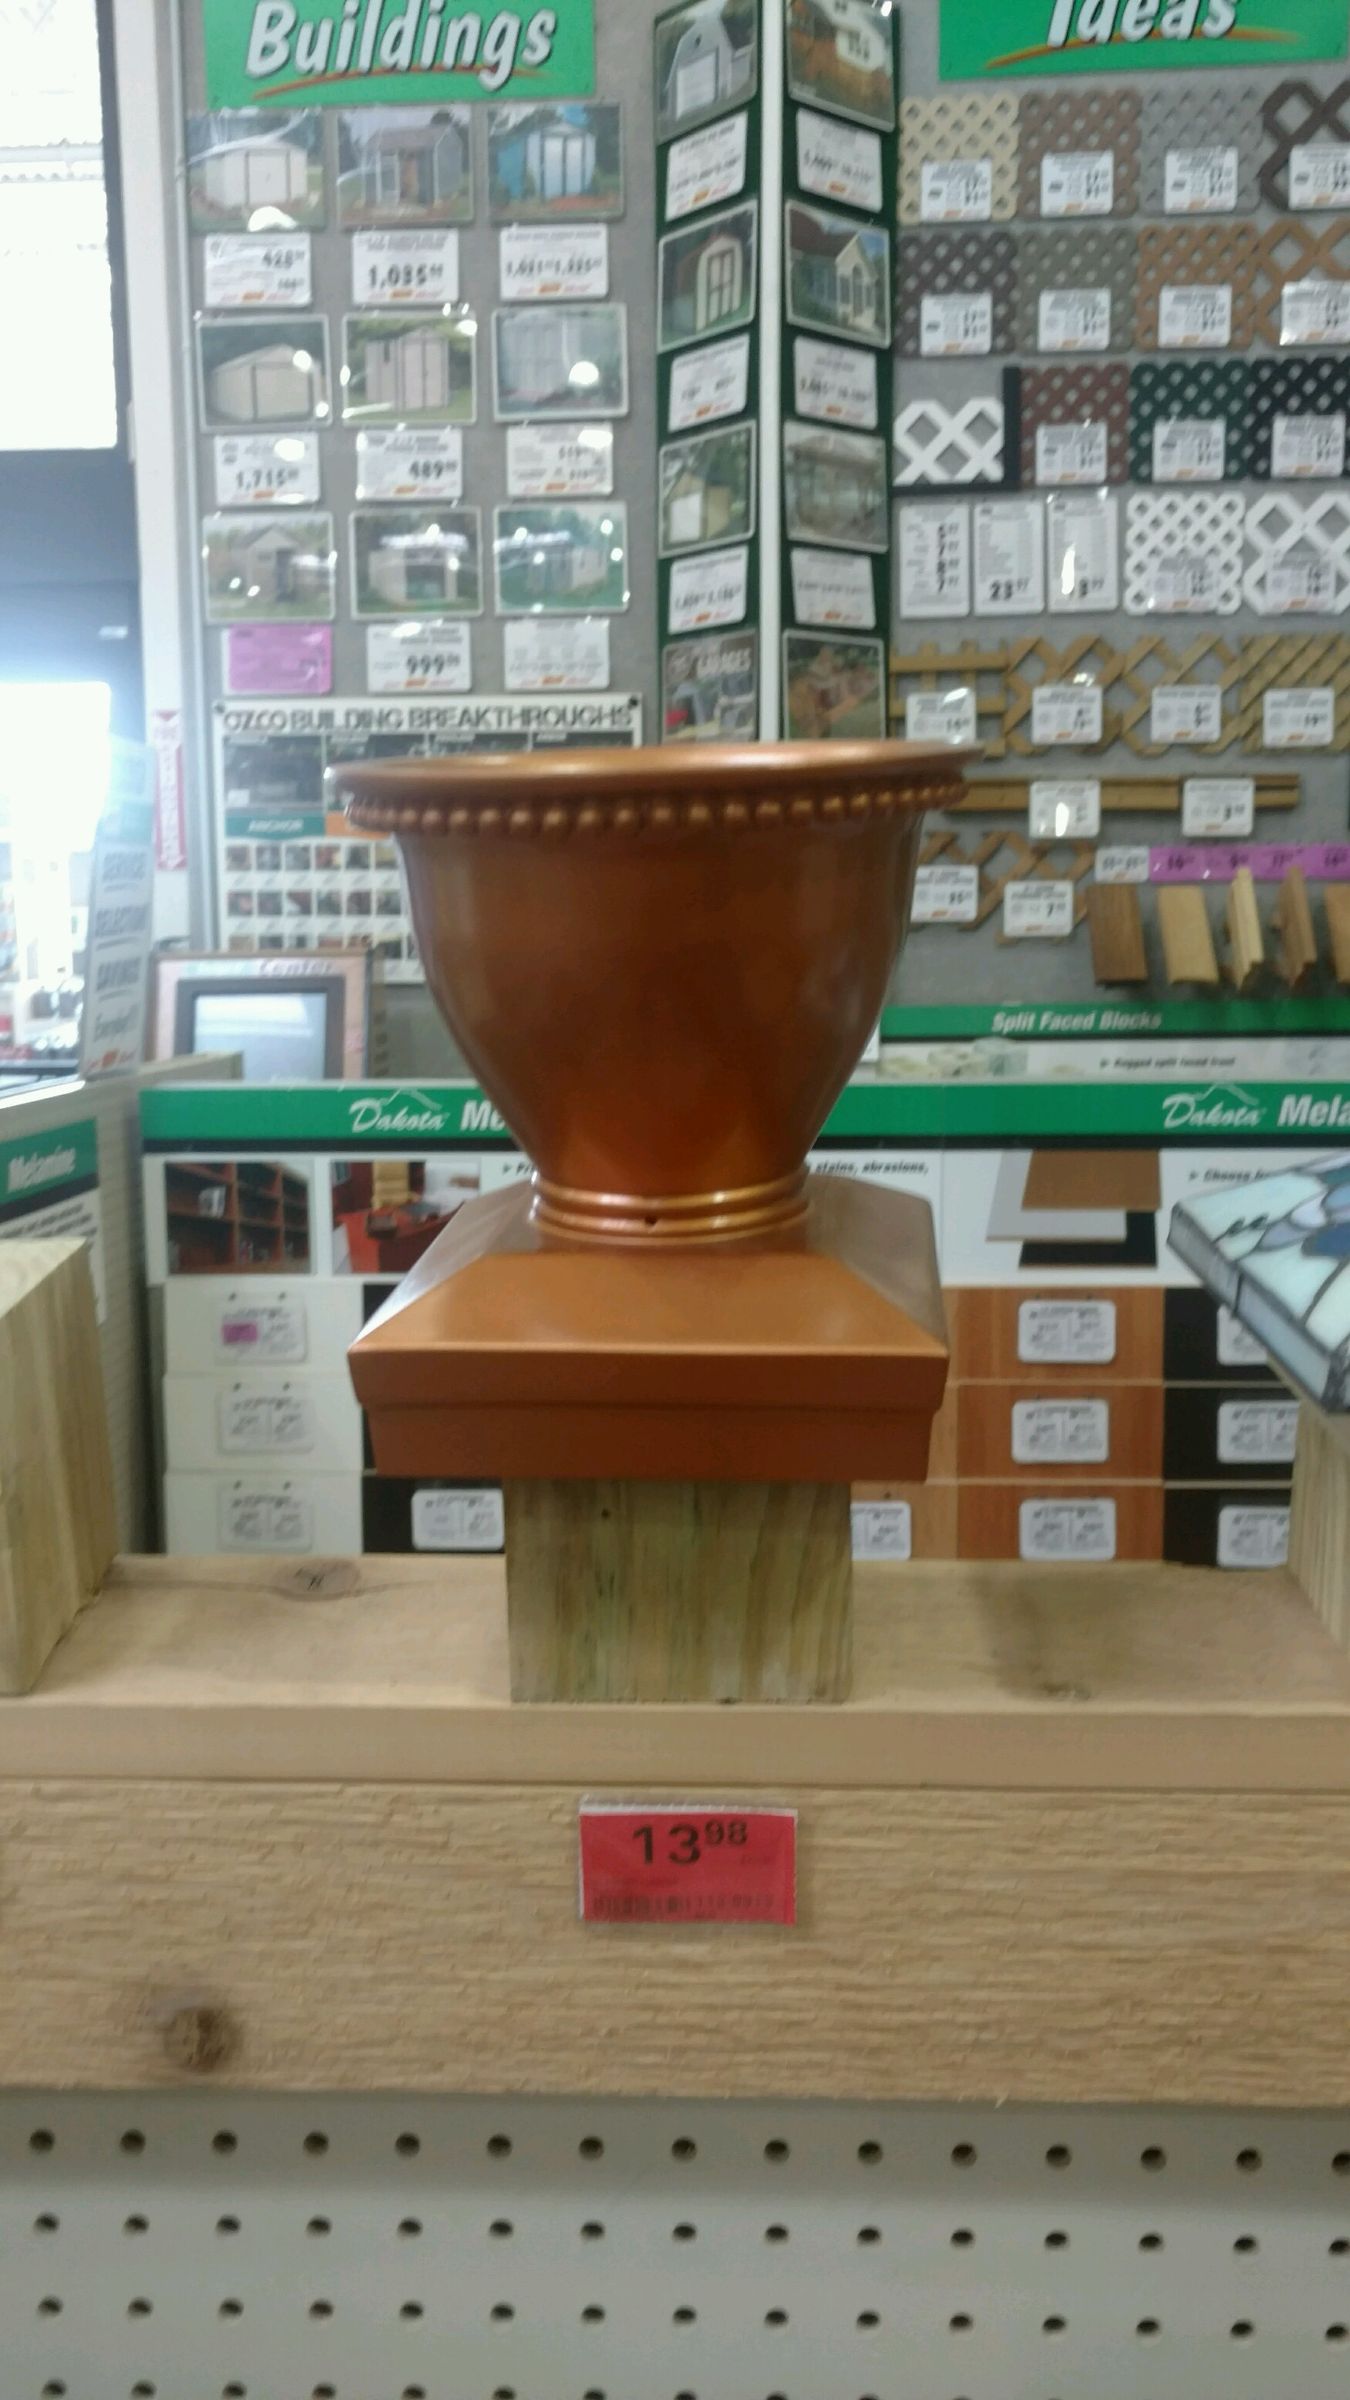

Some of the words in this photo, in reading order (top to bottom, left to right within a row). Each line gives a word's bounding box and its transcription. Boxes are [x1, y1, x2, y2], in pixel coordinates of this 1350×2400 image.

[245, 0, 556, 92] Buildings
[223, 709, 287, 731] OZCO
[290, 708, 402, 731] BUILDING
[408, 704, 633, 730] BREAKTHROUGHS
[992, 1011, 1035, 1035] Split
[1039, 1010, 1096, 1032] Faced
[1099, 1010, 1163, 1031] Blocks
[349, 1099, 447, 1134] Dakota
[1161, 1092, 1262, 1130] Dakota
[1202, 1168, 1250, 1183] Choose
